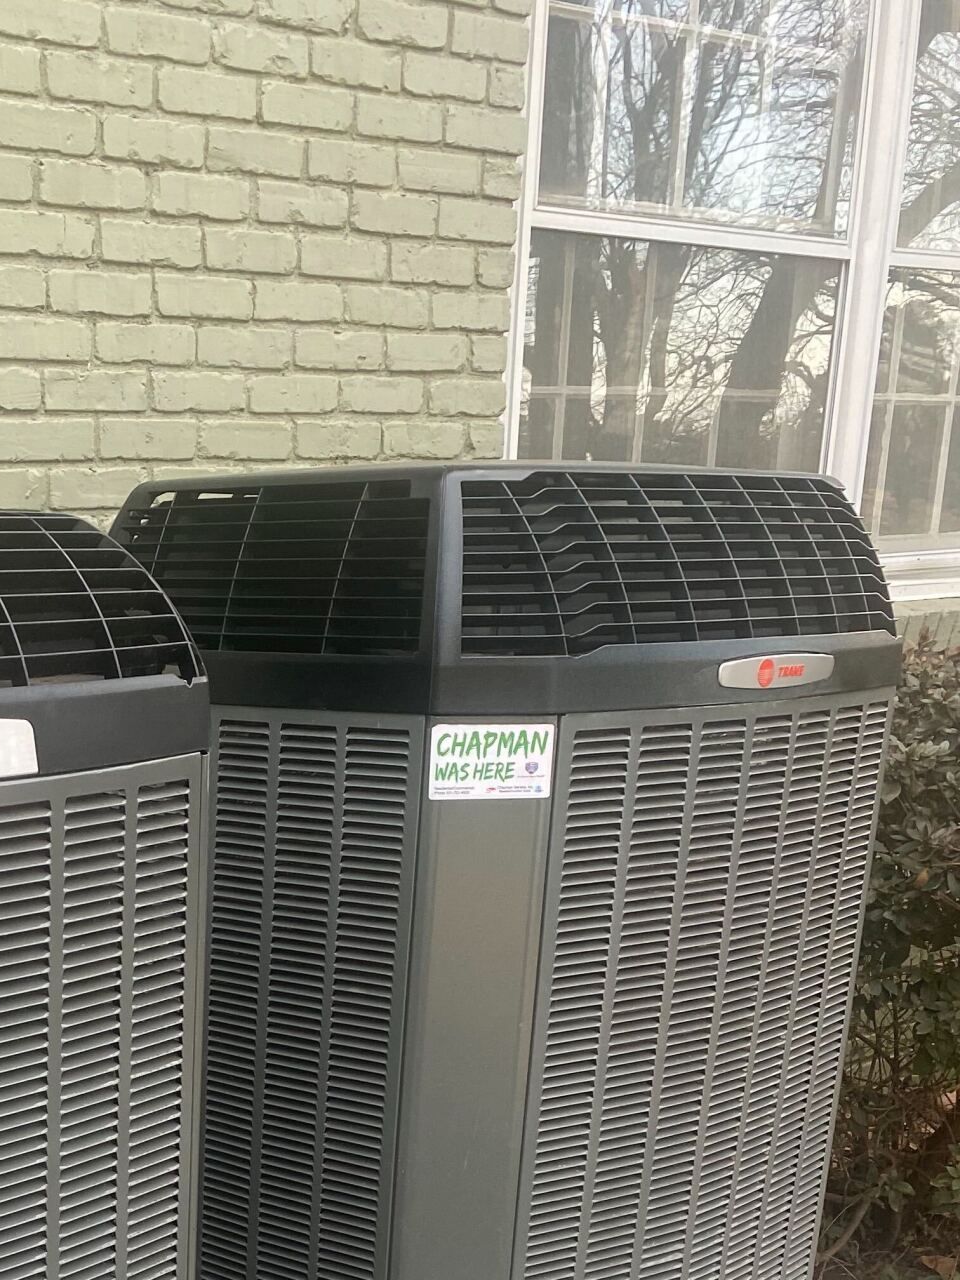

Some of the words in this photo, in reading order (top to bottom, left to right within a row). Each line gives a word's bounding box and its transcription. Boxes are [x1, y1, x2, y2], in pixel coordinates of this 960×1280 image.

[778, 664, 805, 678] TRANE
[436, 729, 549, 760] CHAPMAN
[434, 761, 470, 783] WAS
[473, 761, 516, 783] HERE
